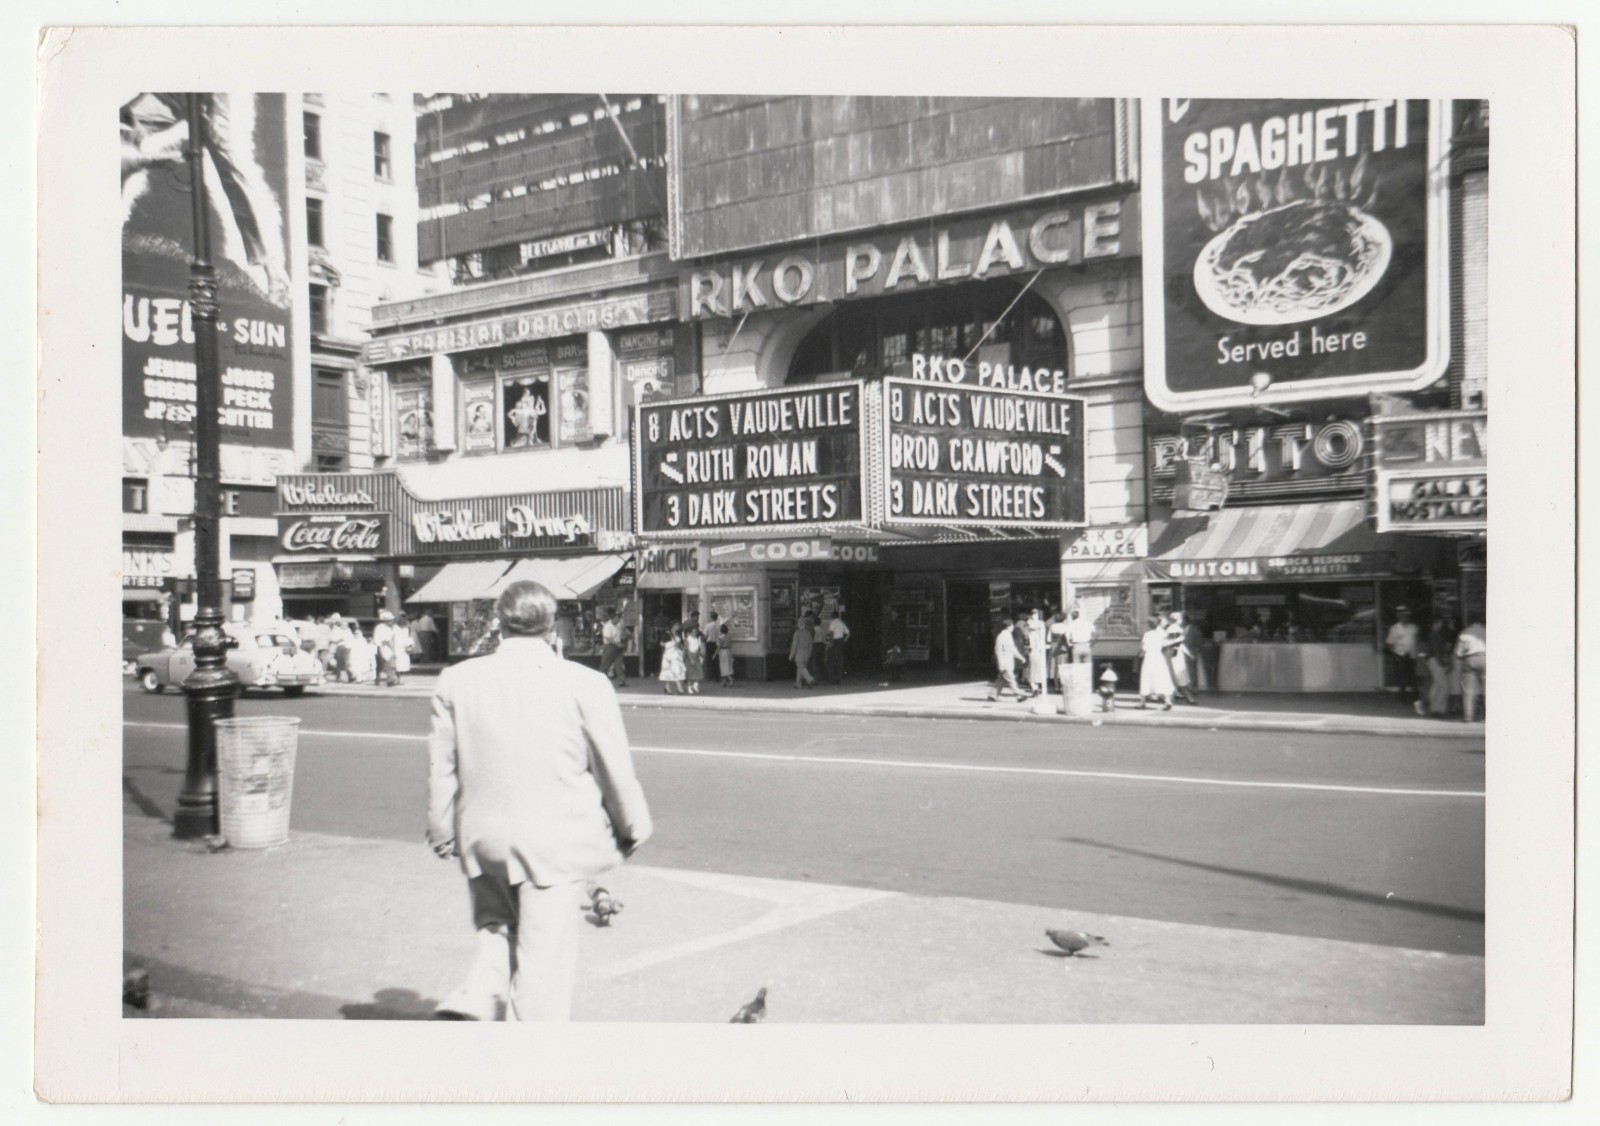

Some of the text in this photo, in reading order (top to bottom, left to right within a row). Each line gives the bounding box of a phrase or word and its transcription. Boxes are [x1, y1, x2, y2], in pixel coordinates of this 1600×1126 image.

[1184, 98, 1407, 184] SPAGHETTI
[690, 200, 1122, 319] RKO PALACE
[233, 318, 286, 348] SUN
[1217, 327, 1368, 364] Served here
[912, 353, 1065, 395] RKO PALACE
[648, 391, 851, 443] 8 ACTS VAUDEVILLE
[891, 388, 1071, 436] 8 ACTS VAUDEVILLE
[686, 440, 818, 484] RUTH ROMAN
[891, 433, 1043, 476] BROD CRAWFORD
[667, 484, 838, 527] 3 DARK STREETS
[891, 479, 1046, 519] 3 DARK STREETS
[751, 540, 829, 560] COOL
[831, 546, 878, 562] COOL
[1071, 543, 1135, 556] PALACE
[1080, 530, 1124, 542] RKO
[1169, 560, 1259, 578] BUITONI
